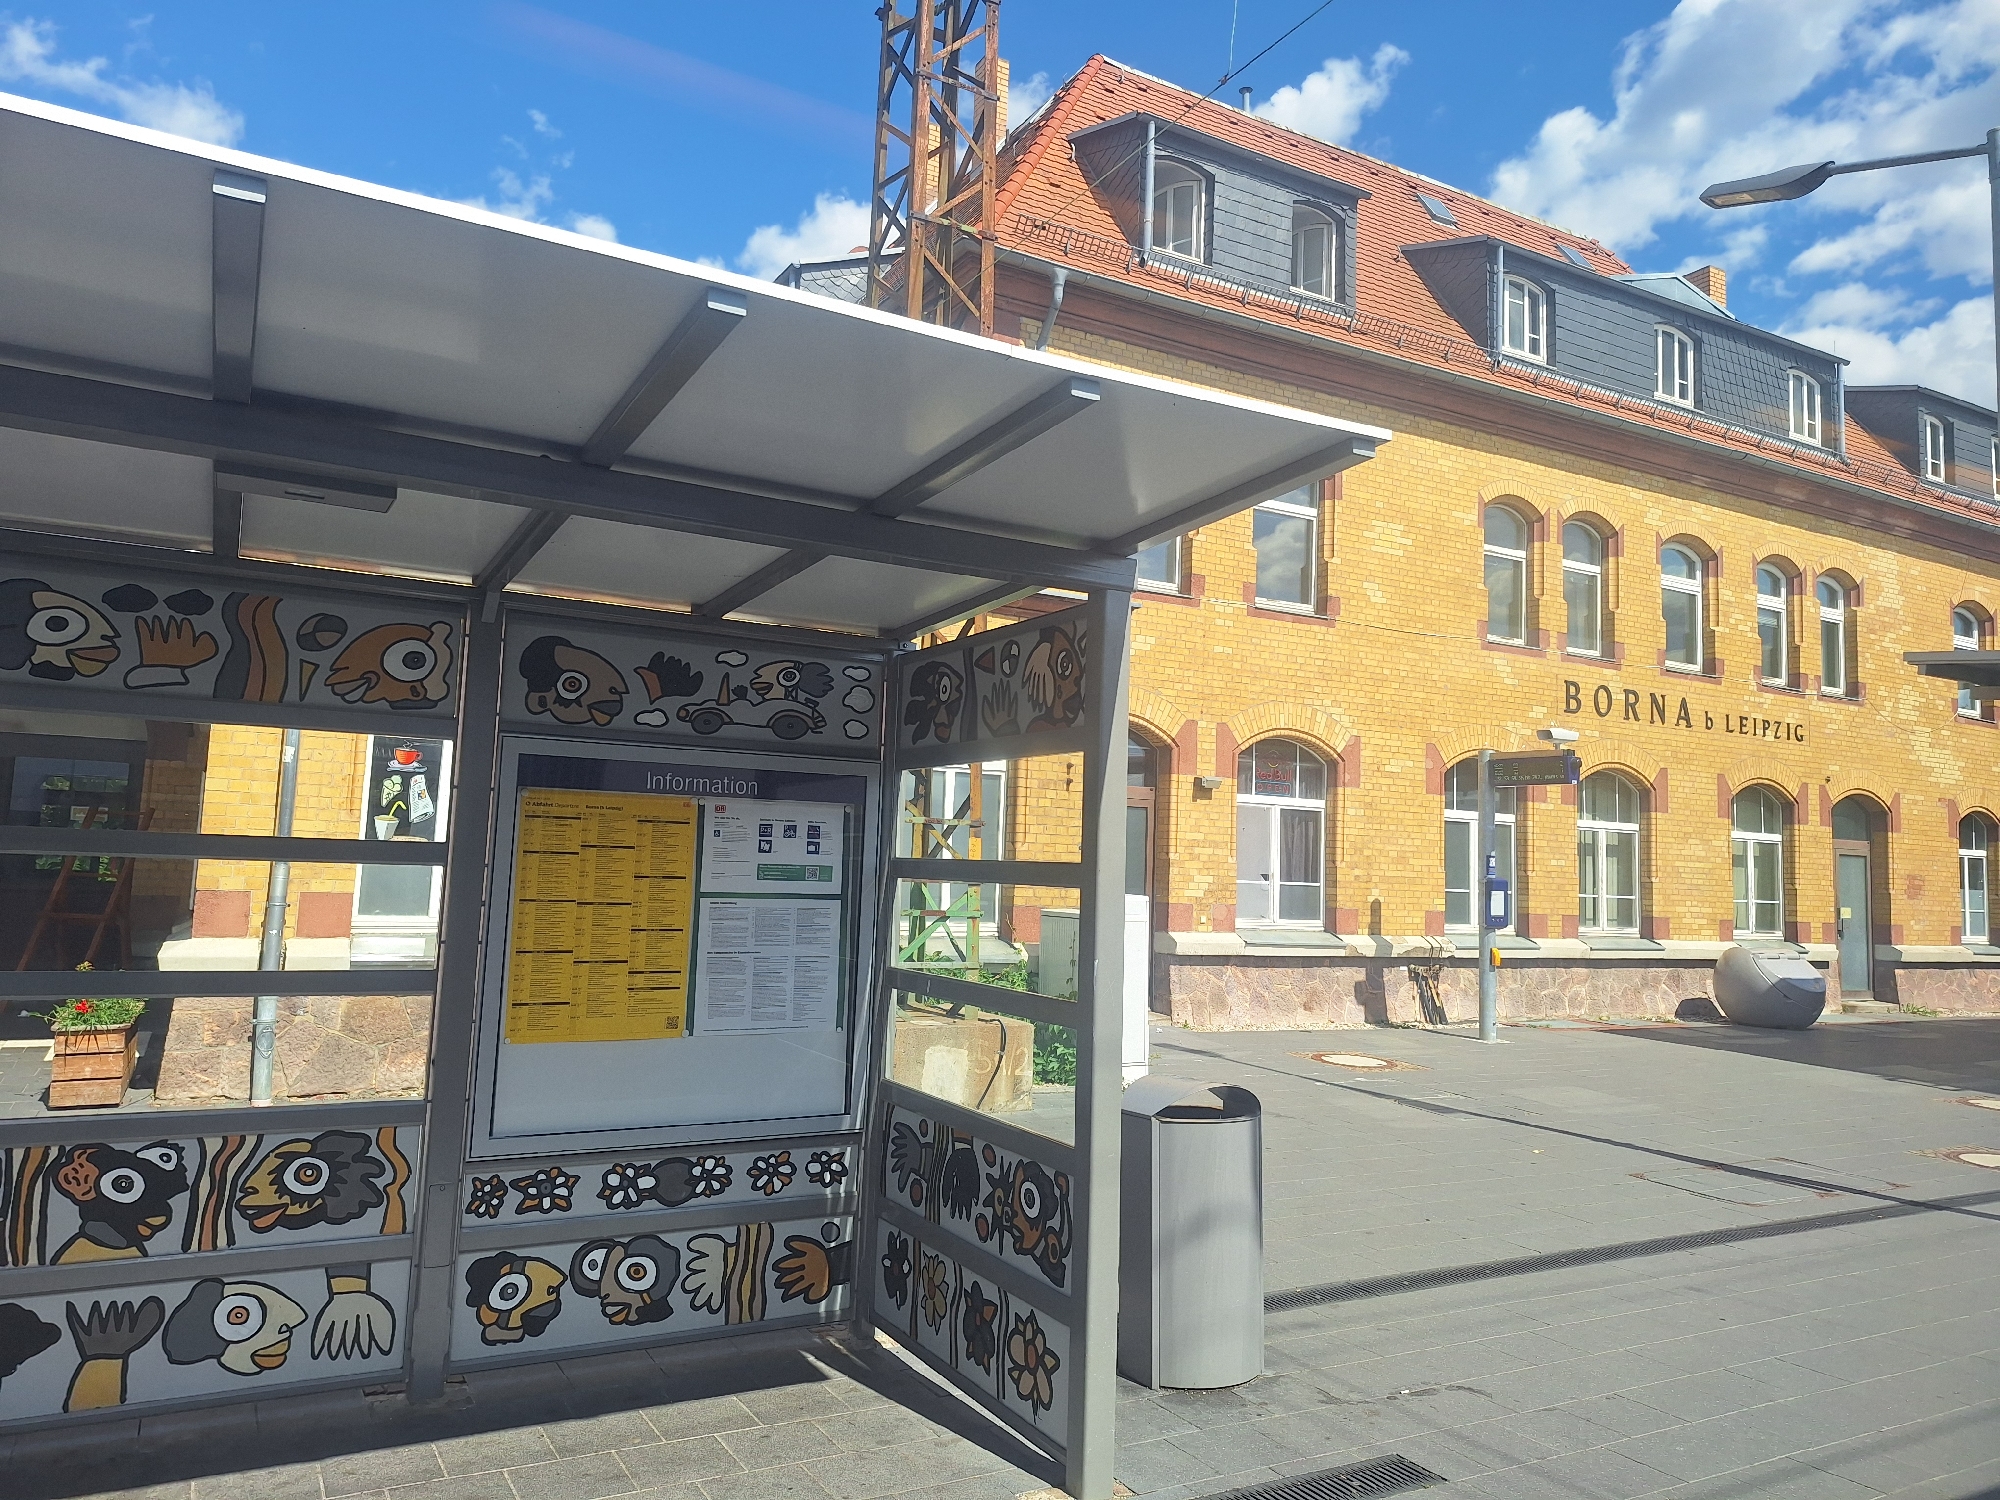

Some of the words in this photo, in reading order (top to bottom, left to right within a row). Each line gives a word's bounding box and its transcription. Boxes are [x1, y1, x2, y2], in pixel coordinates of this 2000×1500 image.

[1564, 679, 1693, 728] BORNA
[1705, 711, 1714, 730] b
[1725, 713, 1804, 742] LEIPZIG
[647, 771, 758, 795] Information
[1256, 767, 1273, 780] Red
[1274, 768, 1292, 781] Bull
[1256, 783, 1289, 794] OPEN
